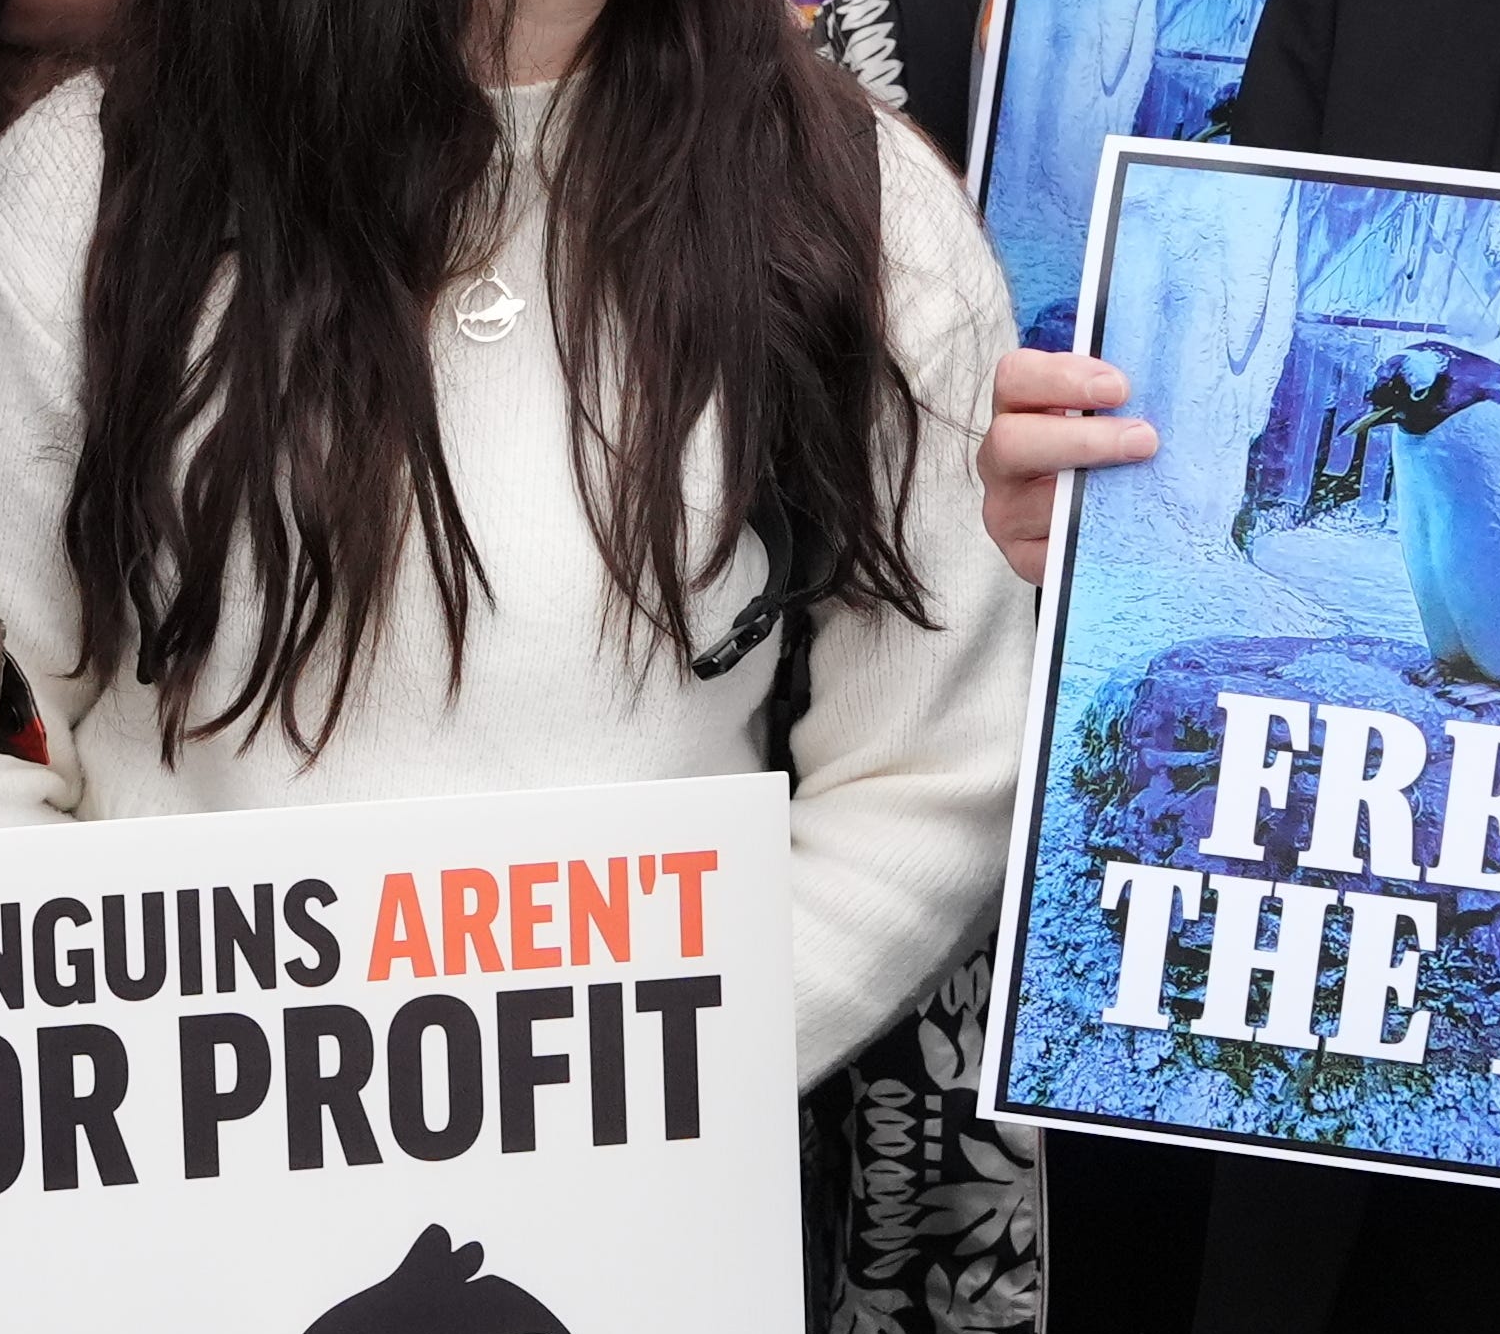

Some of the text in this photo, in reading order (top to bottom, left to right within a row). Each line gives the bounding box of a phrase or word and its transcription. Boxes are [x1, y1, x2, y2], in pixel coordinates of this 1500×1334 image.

[365, 848, 720, 982] AREN'T
[1099, 859, 1438, 1065] THE
[178, 974, 724, 1181] PROFIT
